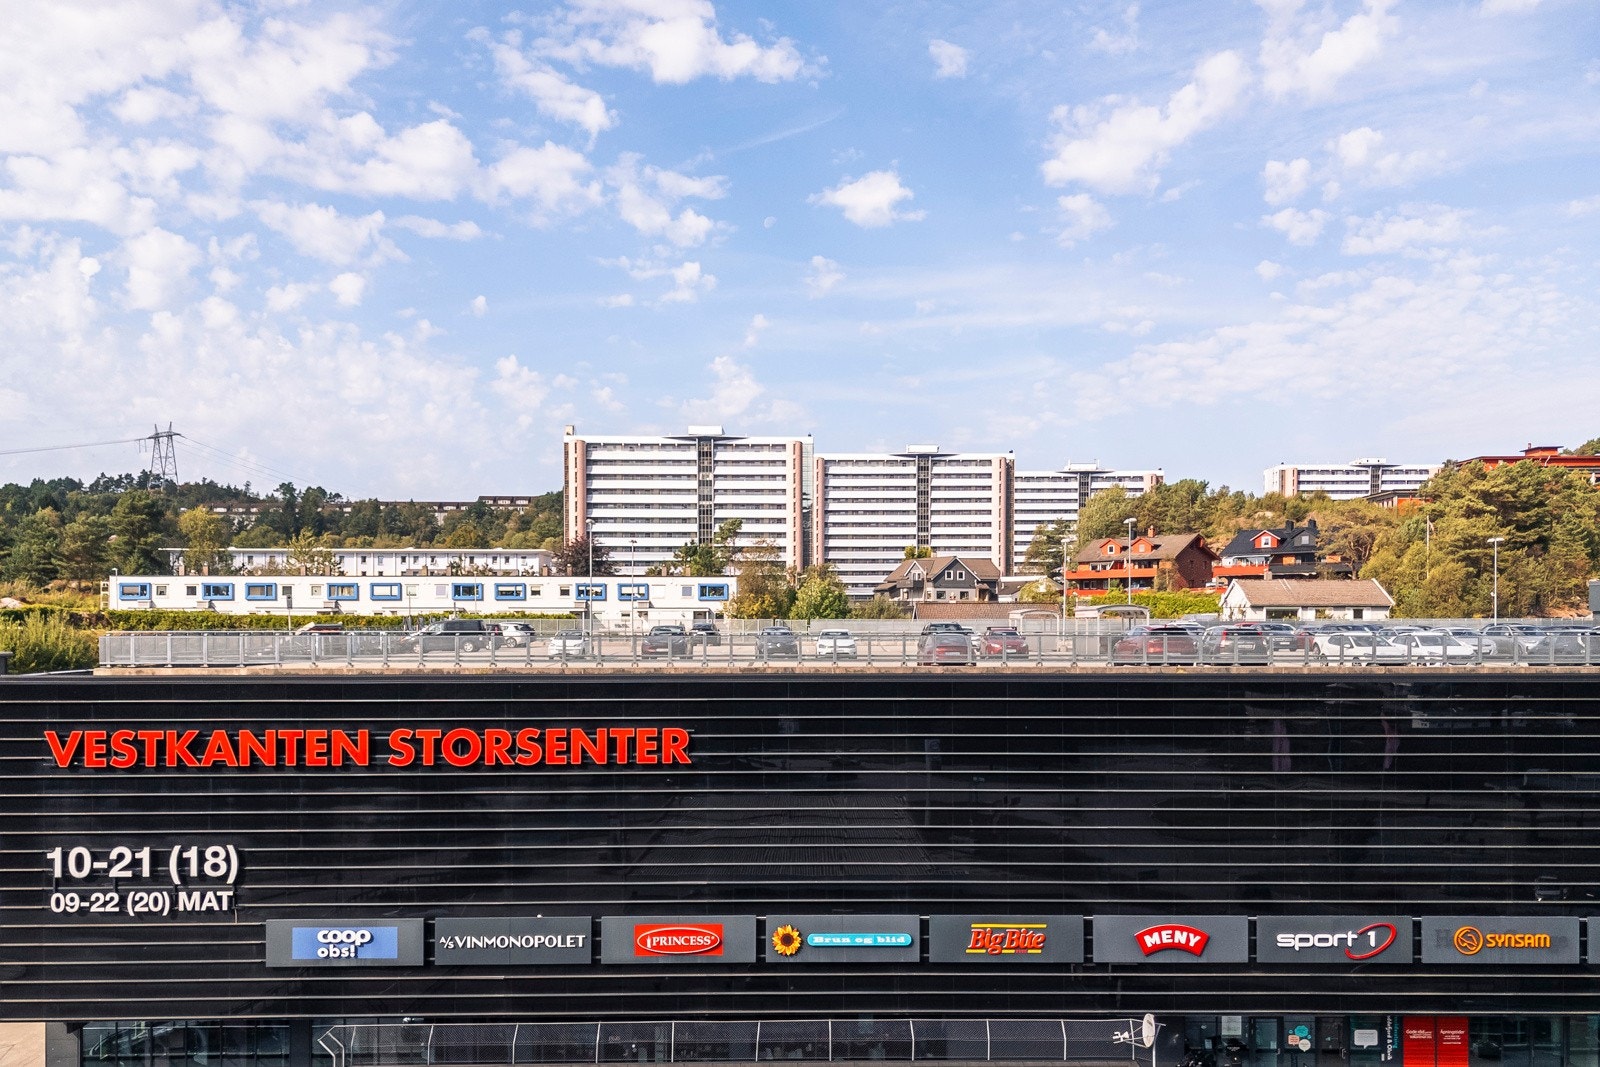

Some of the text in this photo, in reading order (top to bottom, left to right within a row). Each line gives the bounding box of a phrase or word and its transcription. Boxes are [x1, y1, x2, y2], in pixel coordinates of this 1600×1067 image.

[44, 728, 692, 768] VESTKANTEN STORSENTER
[46, 845, 239, 884] 10-21 (18)
[50, 891, 234, 916] 09-22 (20) MAT
[317, 929, 371, 946] coop
[454, 935, 586, 949] VINMONOPOLET
[812, 935, 905, 945] Brun og blid
[967, 928, 1047, 955] Big Bite
[1143, 930, 1202, 948] MENY
[1276, 931, 1376, 951] sport 1
[1485, 933, 1551, 948] SYNSAM
[317, 944, 356, 958] obs!
